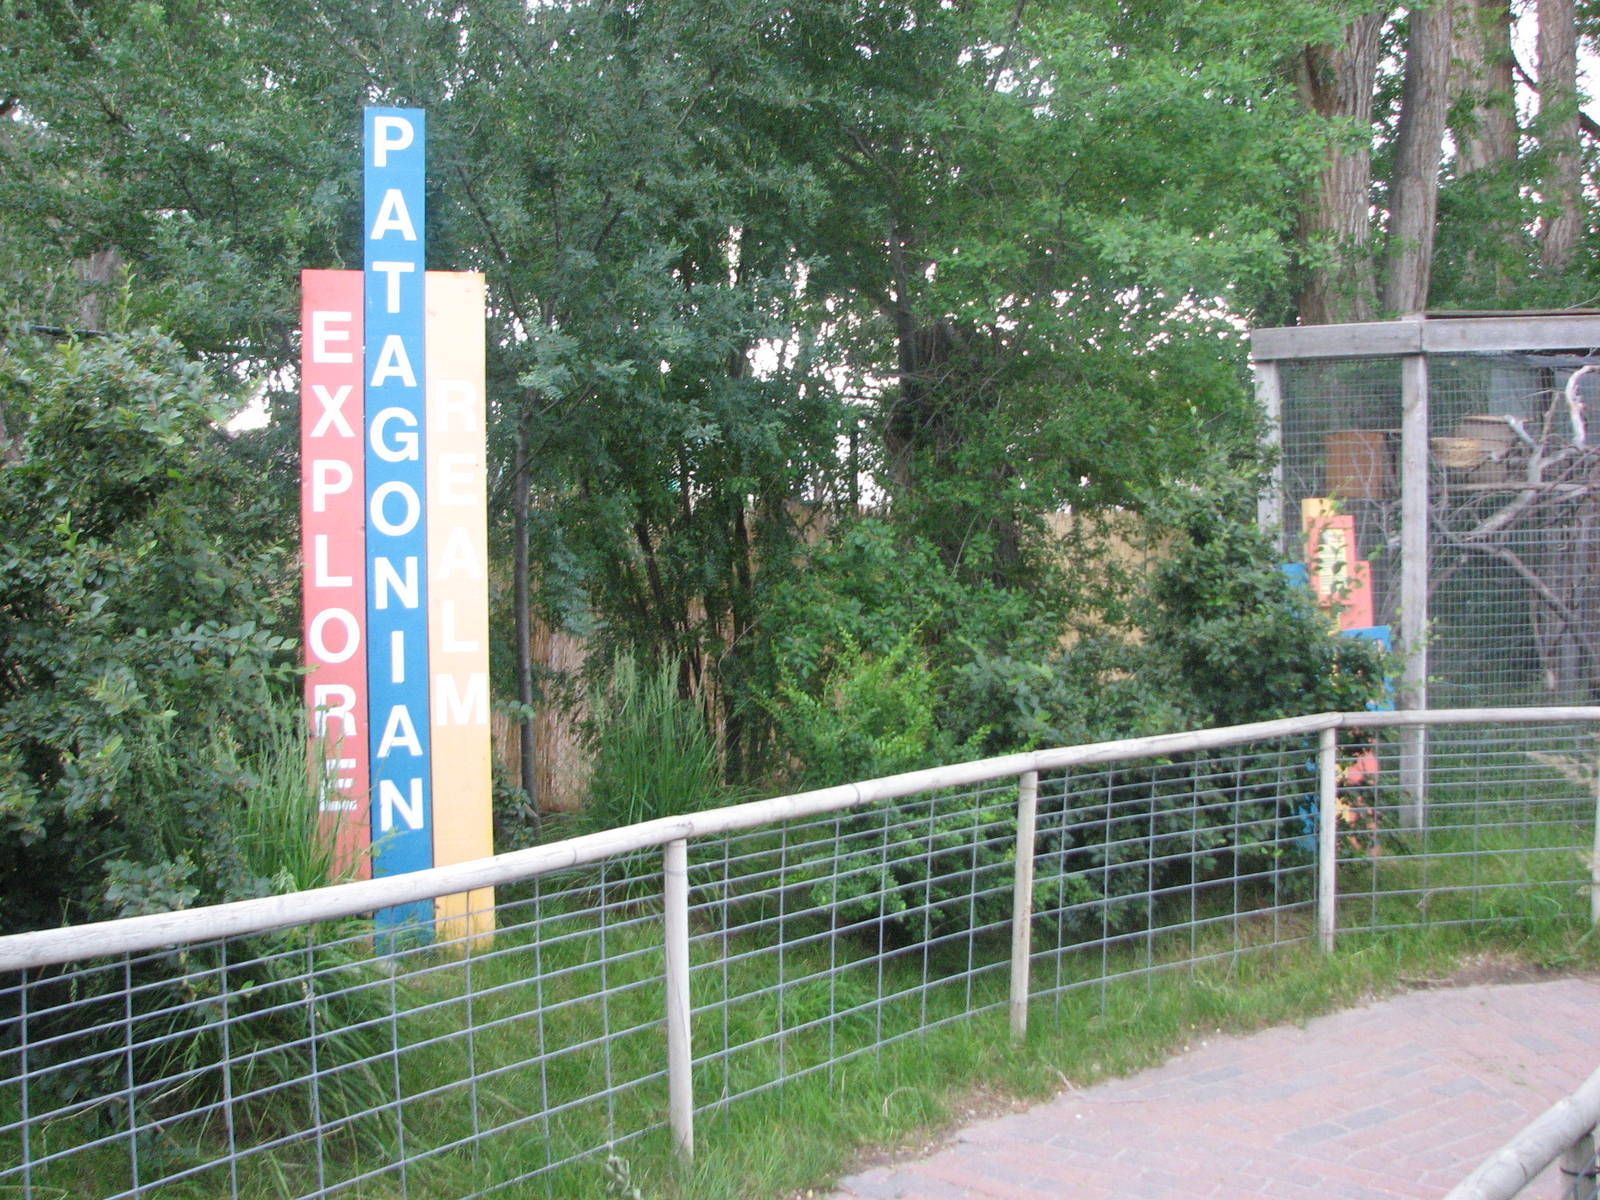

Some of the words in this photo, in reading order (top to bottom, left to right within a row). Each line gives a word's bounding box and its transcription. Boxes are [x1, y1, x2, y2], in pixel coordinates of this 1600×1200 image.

[309, 311, 360, 811] EXPLORE
[370, 116, 424, 832] PATAGONIAN
[435, 381, 488, 726] REALM
